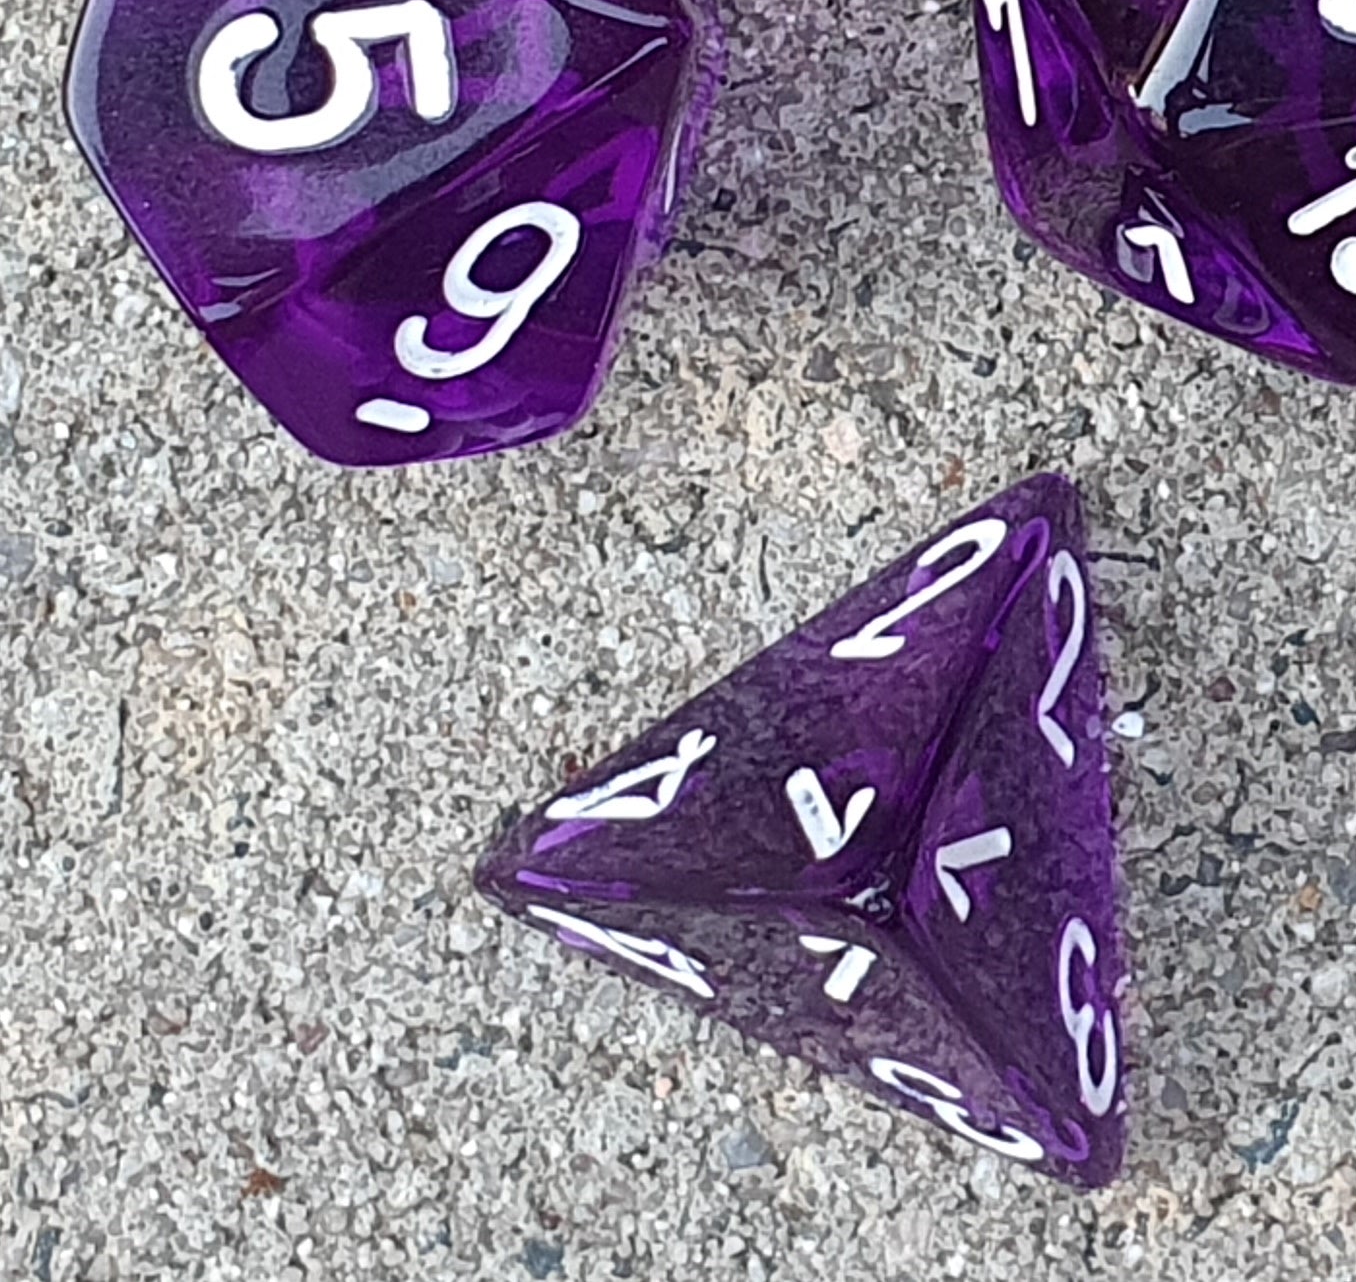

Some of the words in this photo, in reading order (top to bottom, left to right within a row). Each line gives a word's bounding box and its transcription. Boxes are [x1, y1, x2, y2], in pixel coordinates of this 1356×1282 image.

[830, 518, 1007, 658] 2
[1038, 549, 1085, 768] 2
[543, 727, 717, 820] 4
[1059, 917, 1117, 1116] 3
[871, 1057, 1044, 1160] 3
